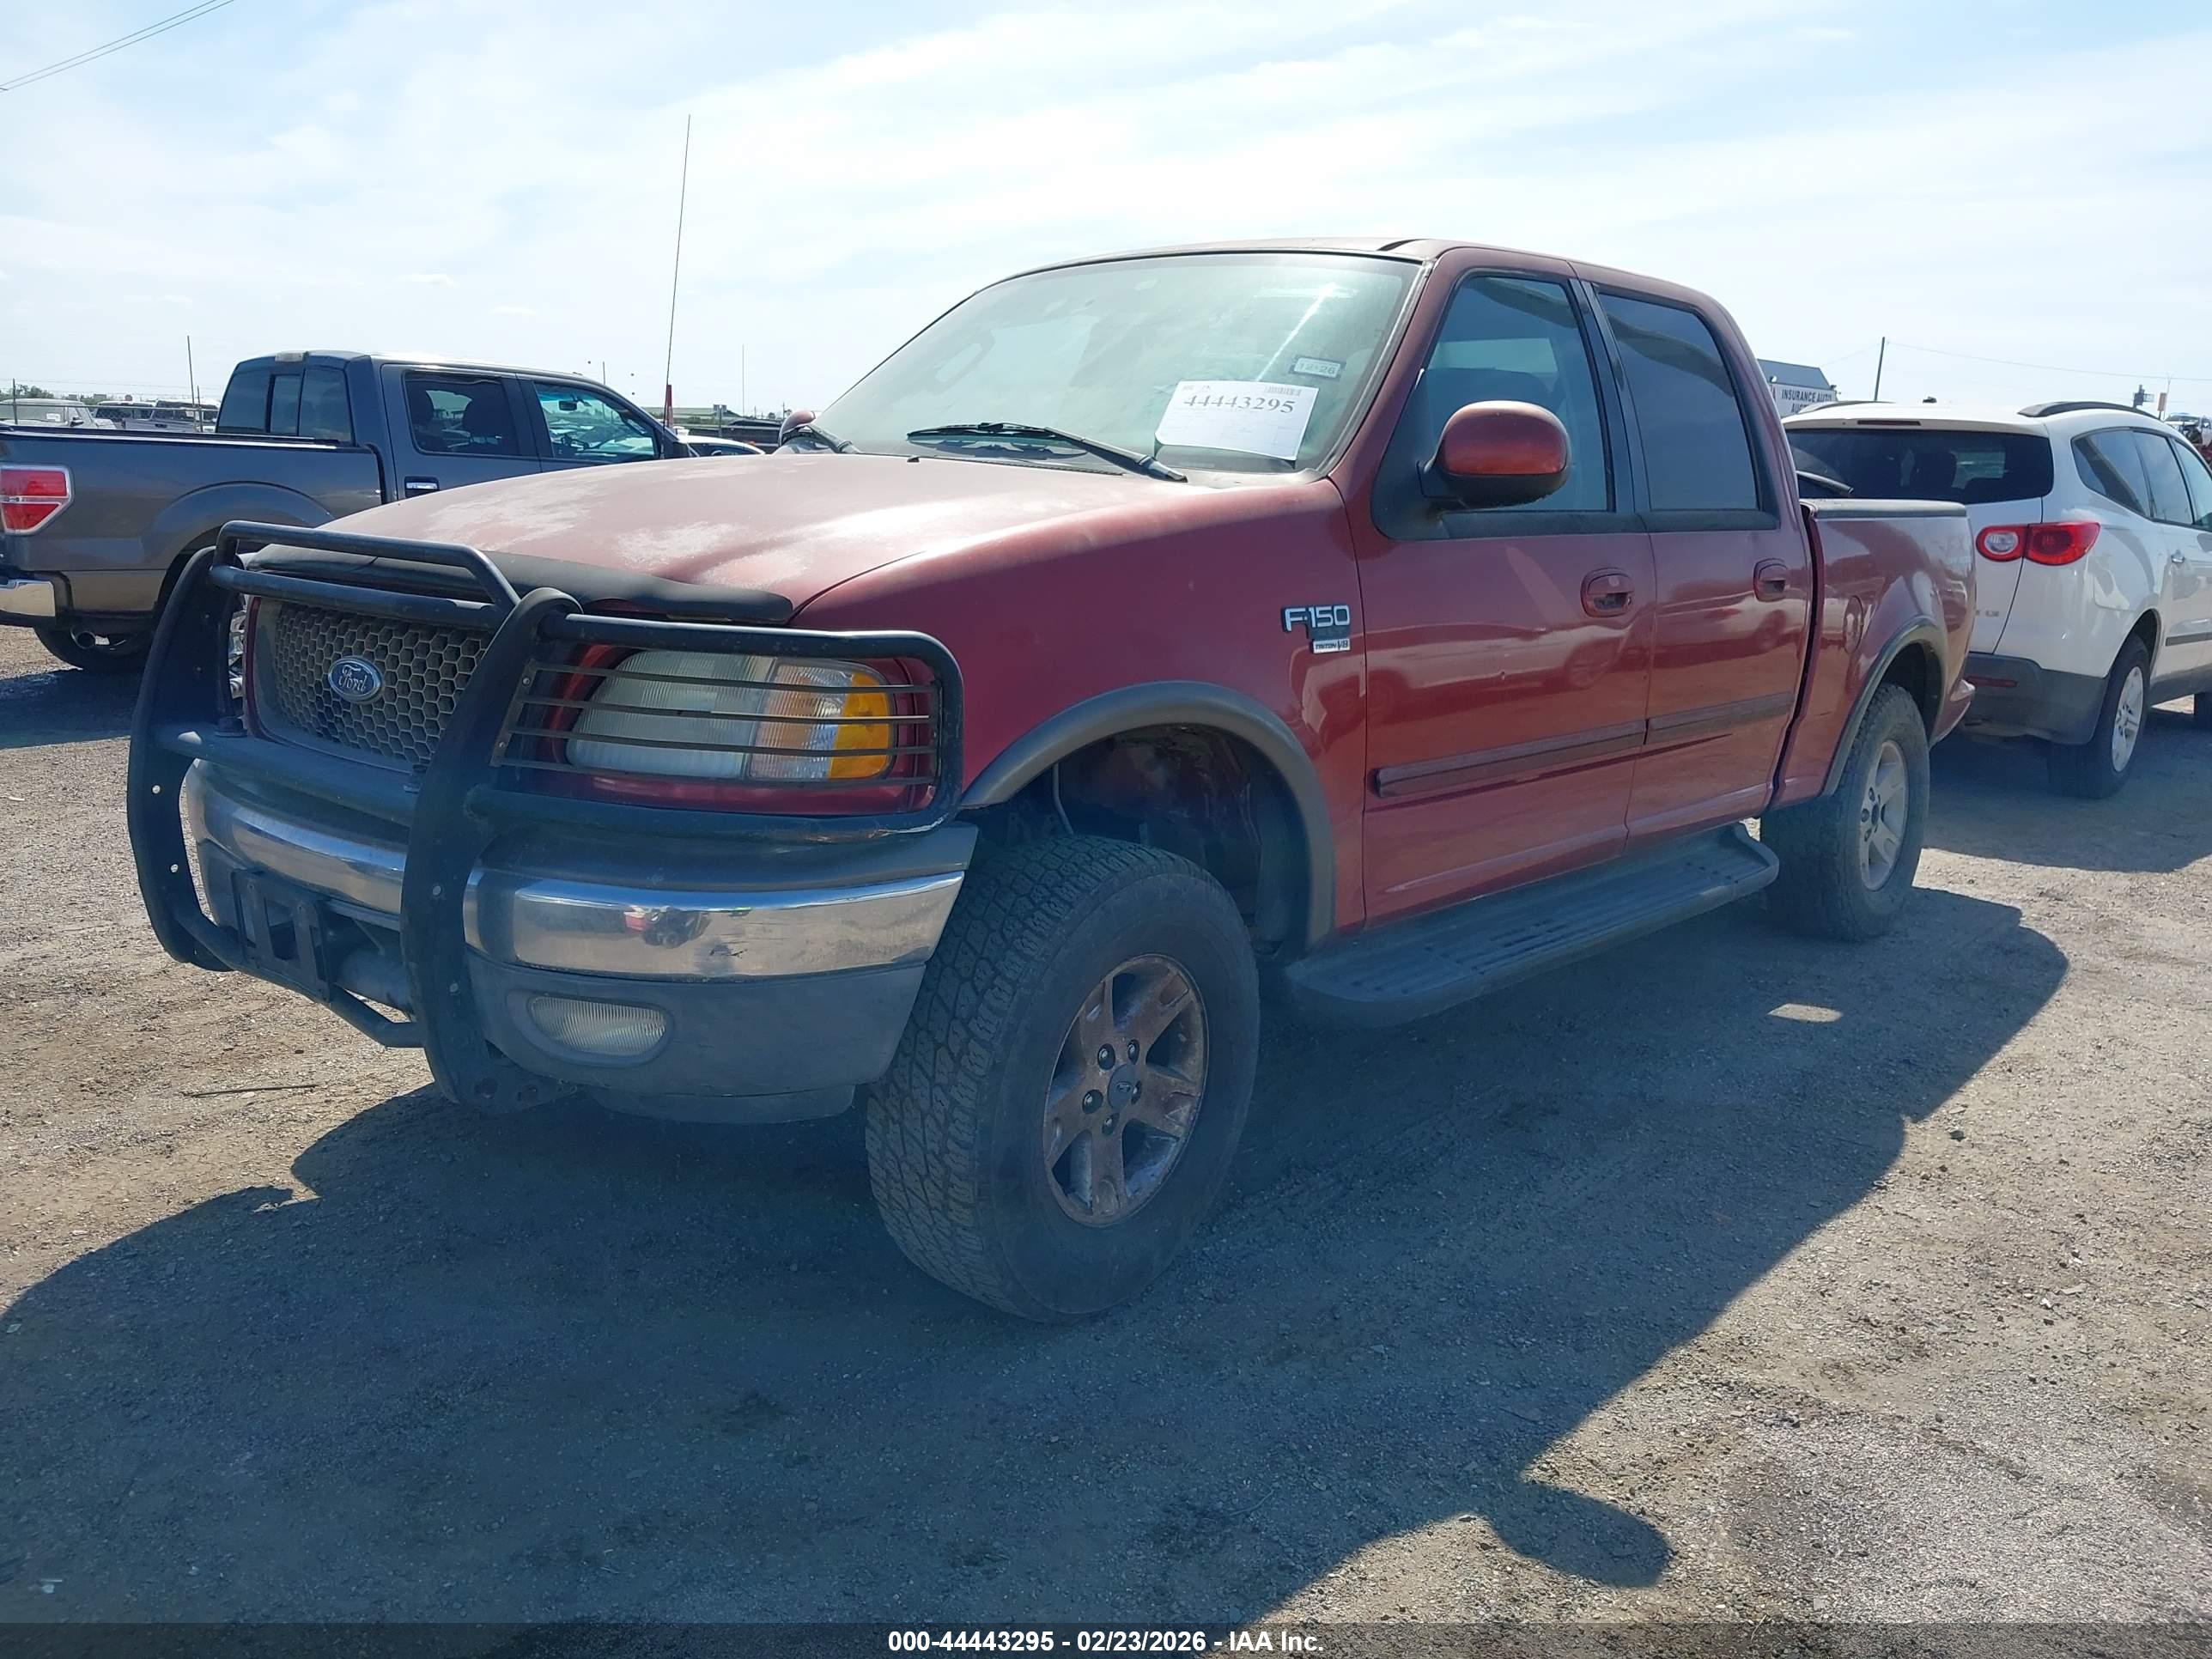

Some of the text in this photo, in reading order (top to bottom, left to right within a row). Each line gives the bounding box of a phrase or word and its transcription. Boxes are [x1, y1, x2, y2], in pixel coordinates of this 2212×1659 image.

[1183, 394, 1296, 413] 44443295
[1782, 389, 1816, 403] INSURANCE
[338, 664, 368, 692] Ford
